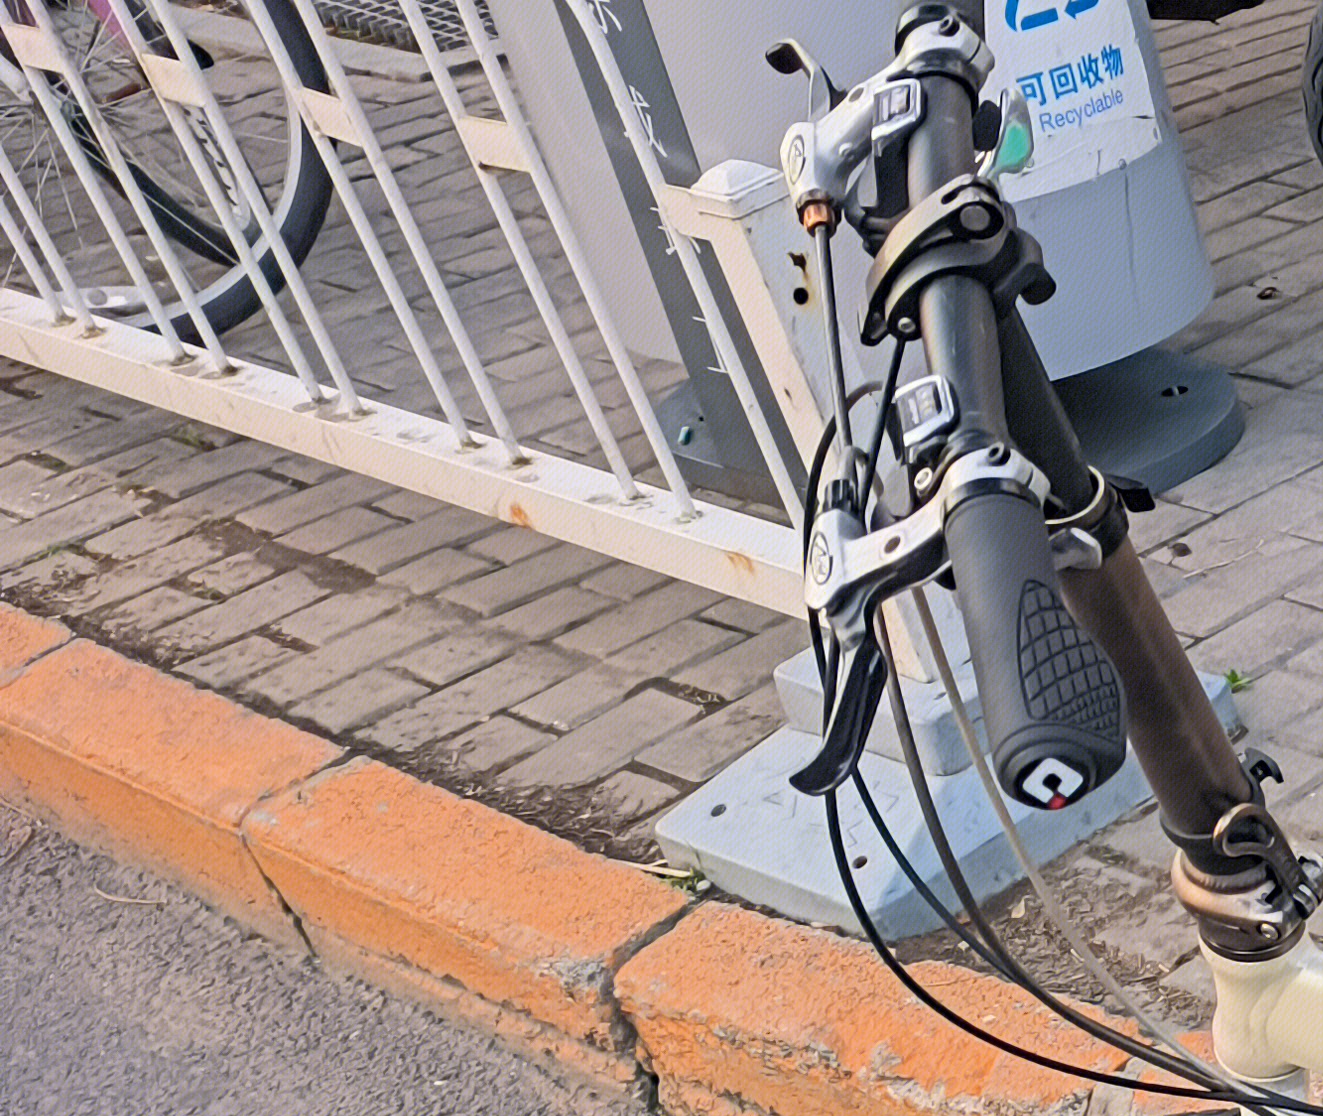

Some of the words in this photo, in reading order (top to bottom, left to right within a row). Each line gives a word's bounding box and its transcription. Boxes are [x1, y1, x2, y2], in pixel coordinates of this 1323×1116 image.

[1016, 44, 1123, 106] 可回收物
[1038, 88, 1123, 132] Recyclable
